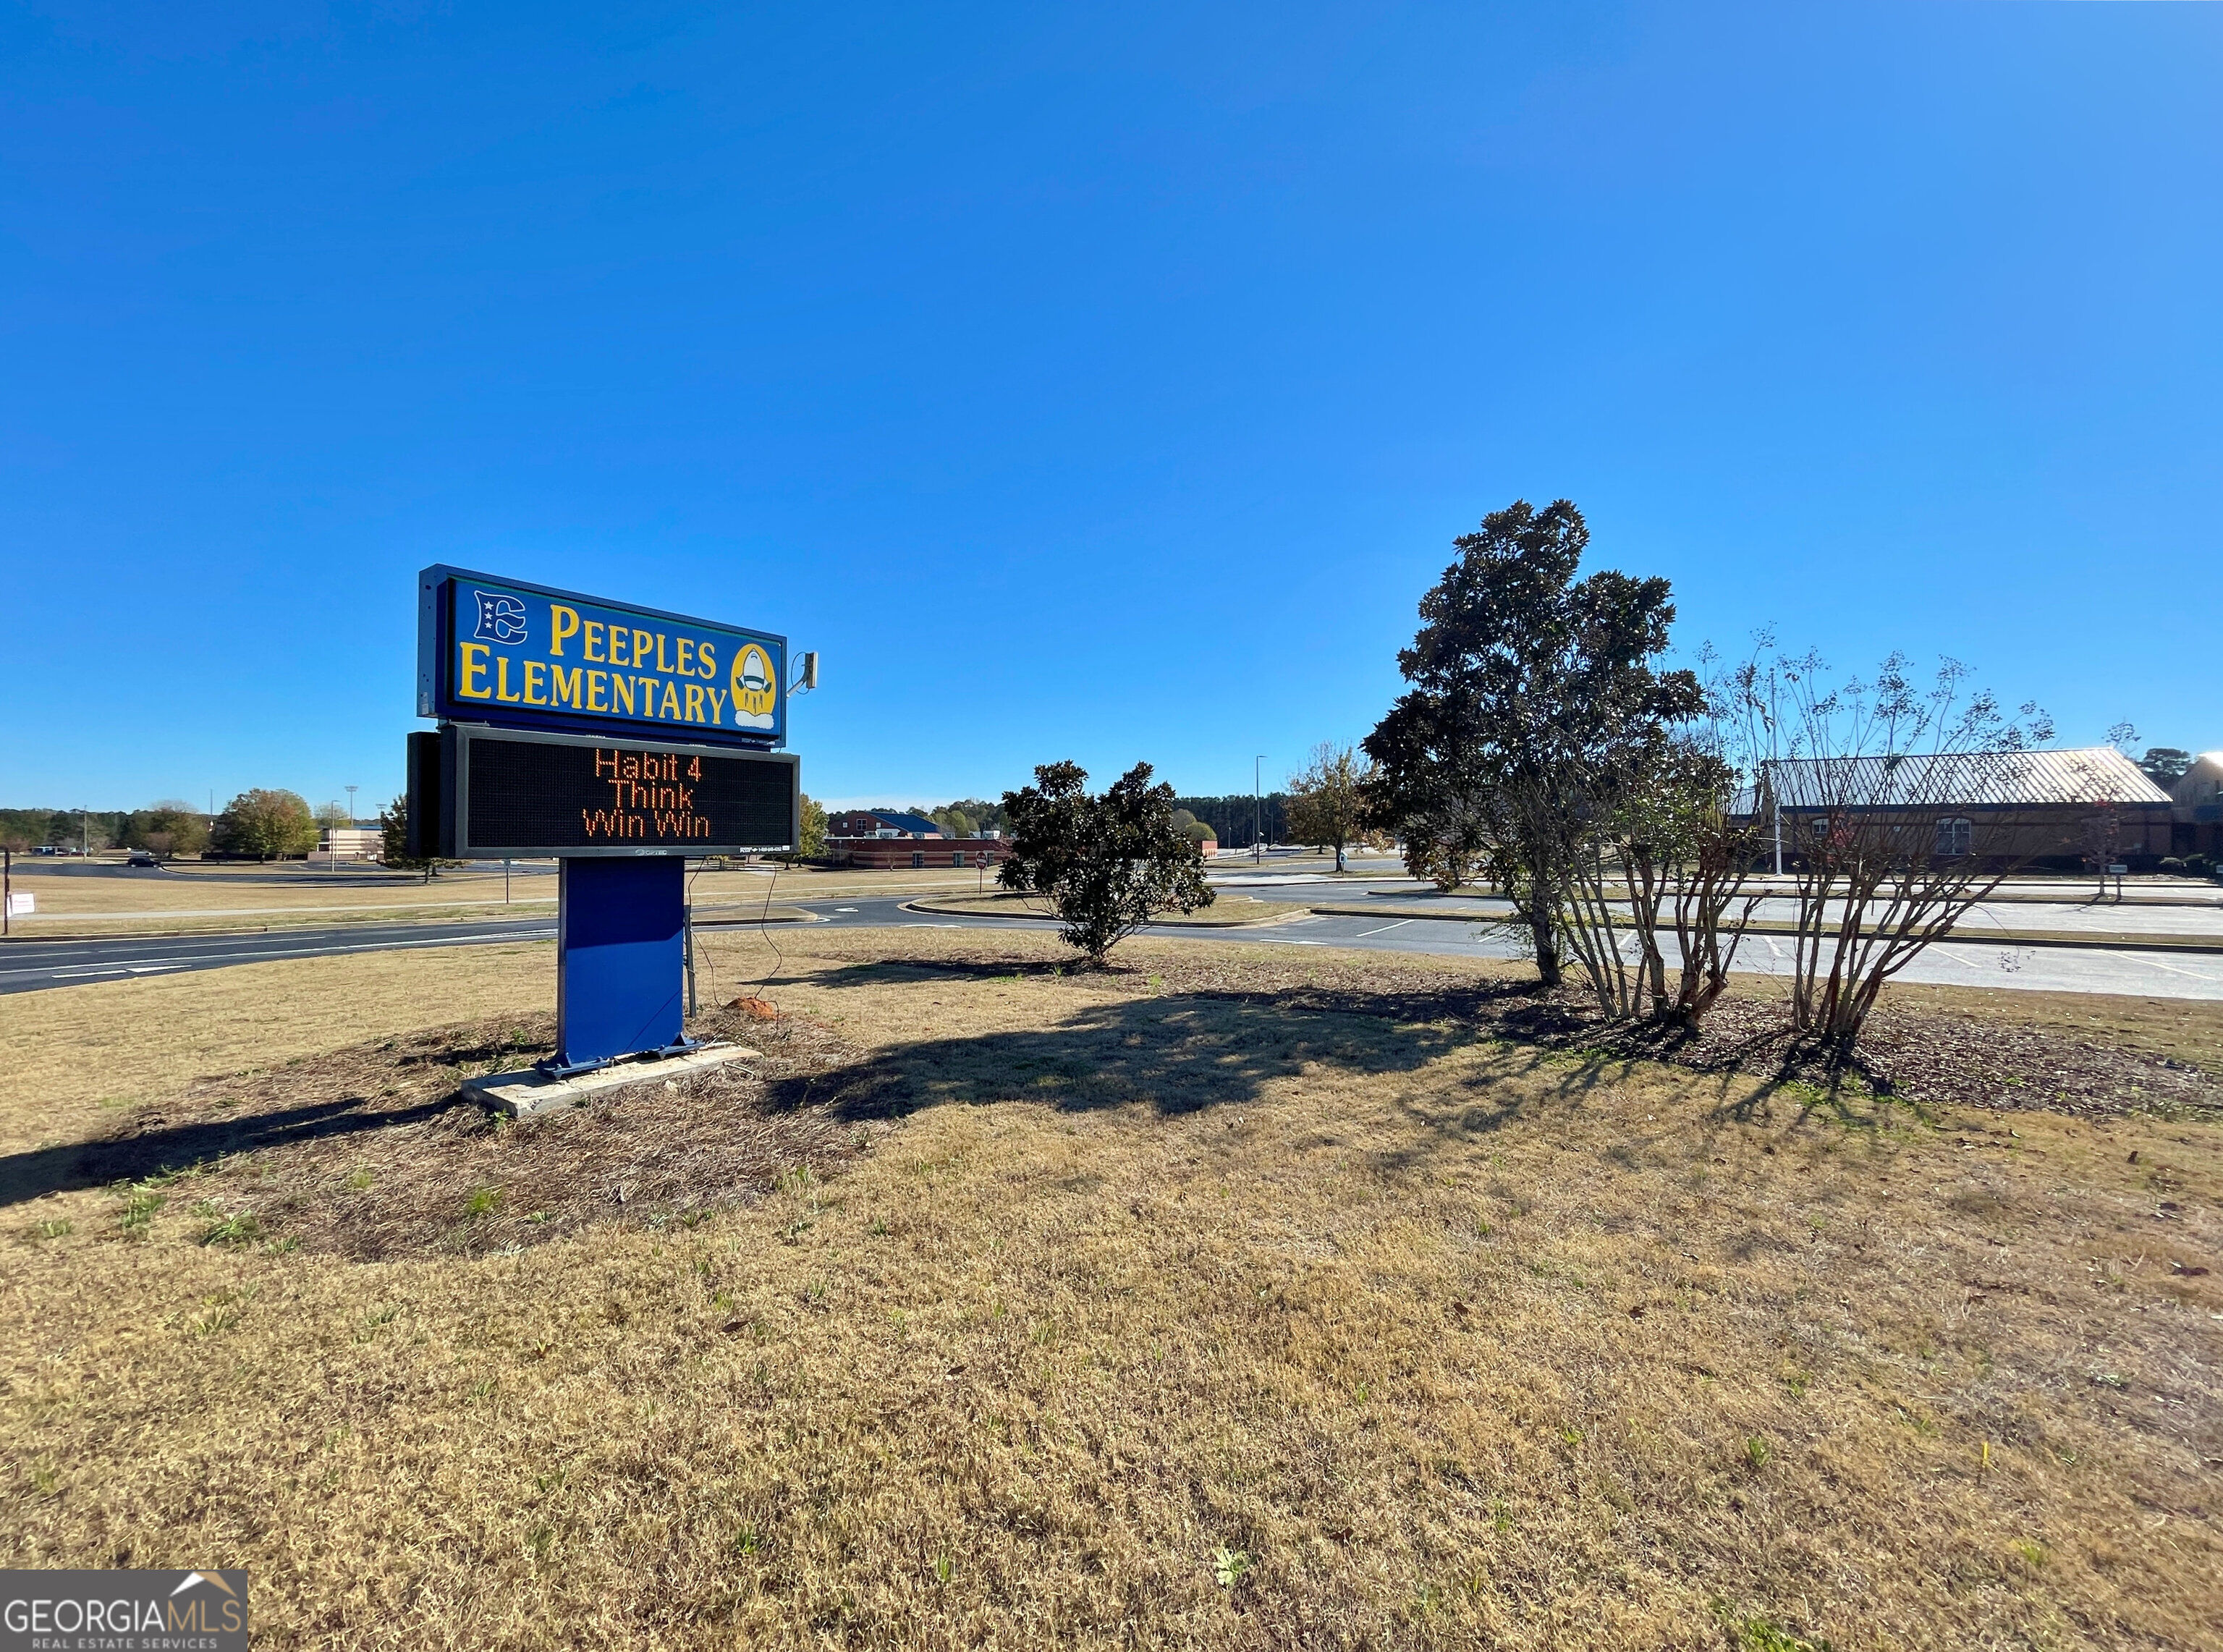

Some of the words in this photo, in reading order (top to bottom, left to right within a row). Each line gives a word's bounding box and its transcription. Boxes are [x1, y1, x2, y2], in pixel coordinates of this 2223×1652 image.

[549, 603, 717, 679] PEEPLES
[459, 641, 728, 725] ELEMENTARY
[596, 747, 678, 781] Habit
[687, 755, 702, 782] 4
[608, 779, 693, 809] Think
[583, 808, 644, 837] Win
[654, 810, 709, 837] Win
